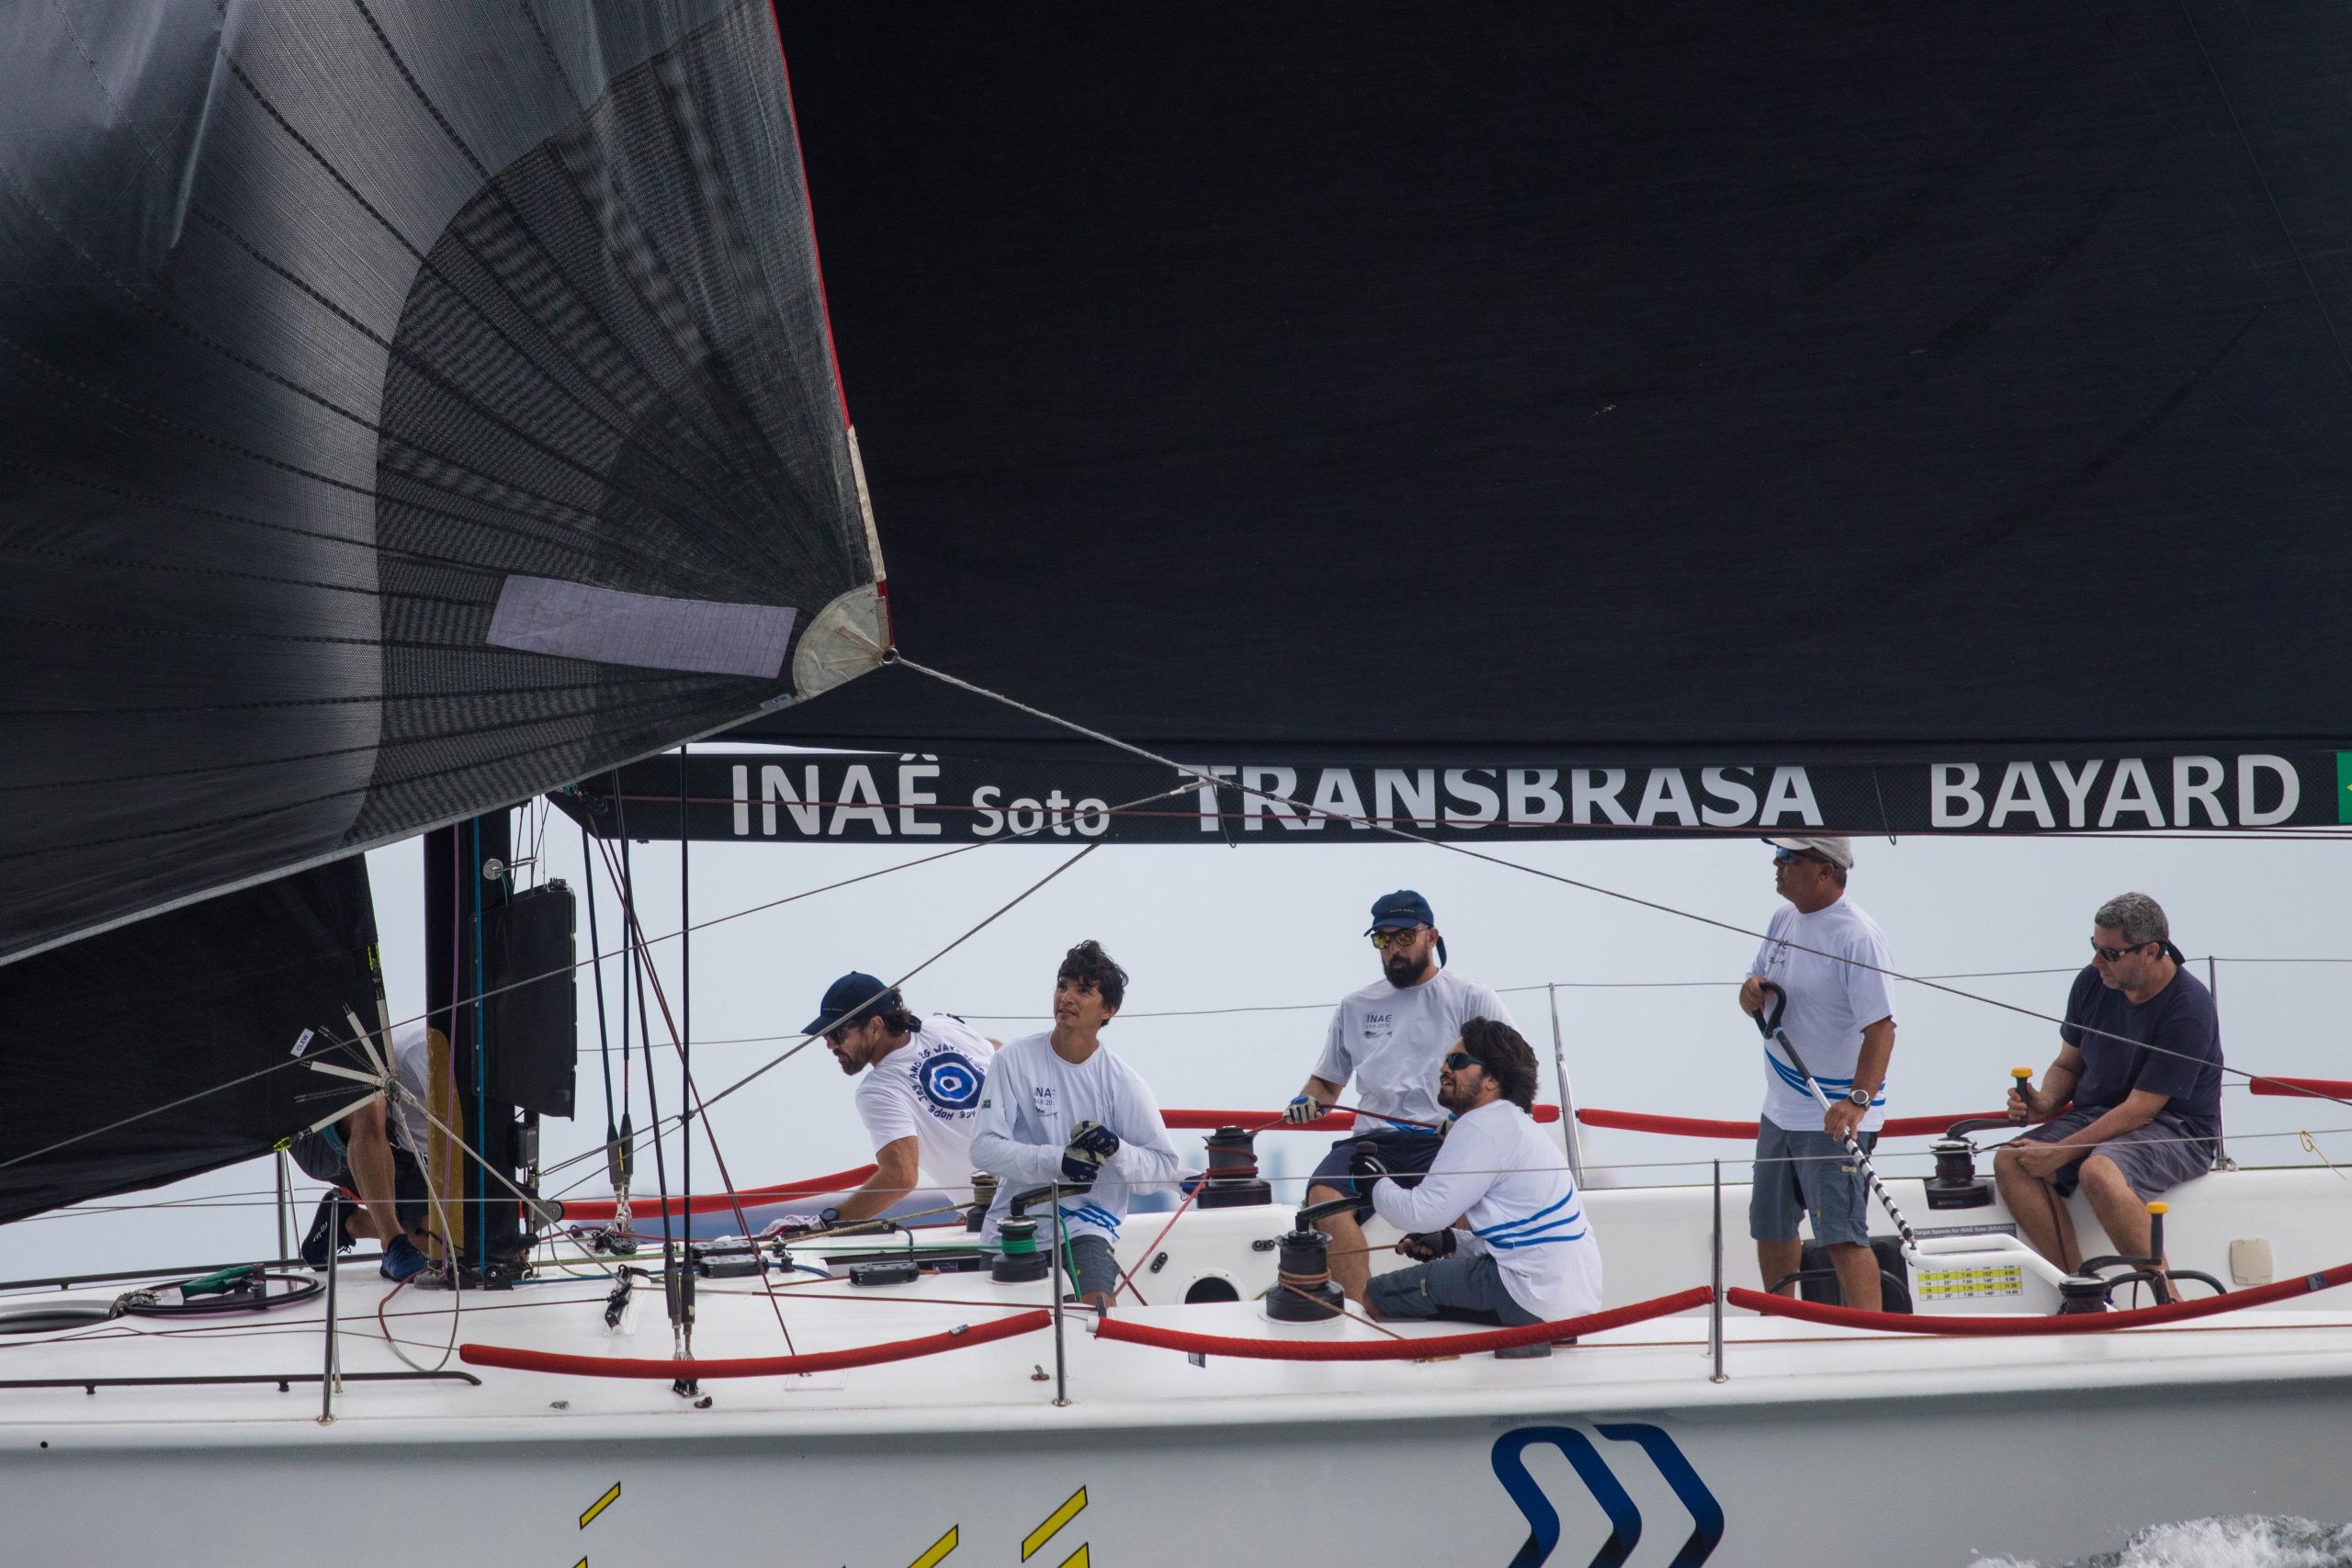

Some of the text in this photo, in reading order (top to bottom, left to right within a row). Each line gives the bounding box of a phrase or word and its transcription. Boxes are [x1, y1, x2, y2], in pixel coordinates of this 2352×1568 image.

[732, 752, 2300, 837] INAÊ Soto TRANSBRASA BAYARD
[1366, 1014, 1392, 1023] INAE
[296, 1034, 309, 1051] CLEW
